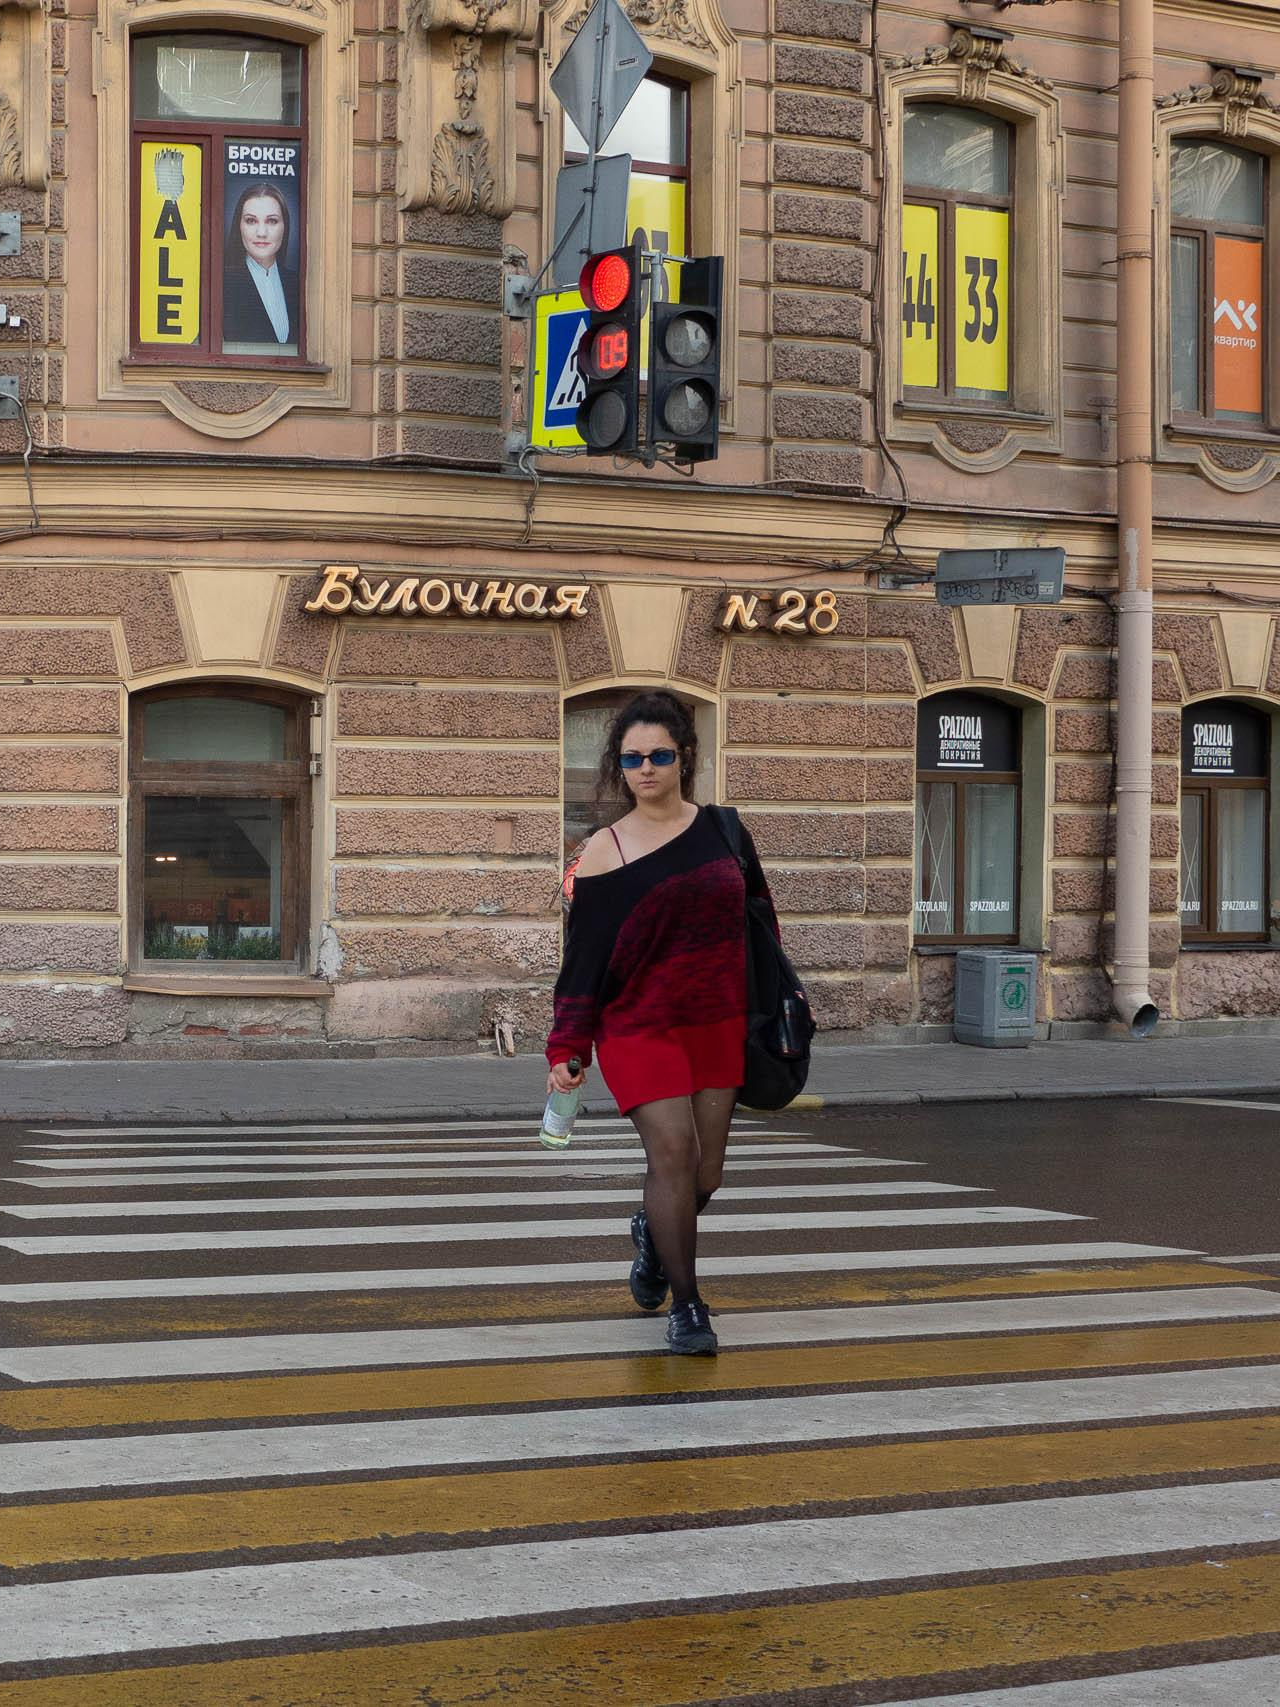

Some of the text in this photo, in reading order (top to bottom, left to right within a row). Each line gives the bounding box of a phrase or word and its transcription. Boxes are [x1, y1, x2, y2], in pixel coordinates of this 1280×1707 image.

[228, 145, 296, 162] БРОКЕР
[228, 162, 296, 176] ОБЪЕКТА
[902, 251, 999, 344] 44 33
[1214, 335, 1257, 350] квартир
[304, 565, 591, 617] Булочная
[773, 590, 839, 635] 28
[938, 715, 982, 739] SPAZZOLA
[1193, 723, 1233, 746] SPAZZOLA
[940, 740, 981, 750] ДЕКОРАТИВНЫЕ
[940, 750, 981, 760] ПОКРЫТИЯ
[1194, 757, 1232, 766] ПОКРЫТИЯ
[969, 901, 1010, 912] SPAZZOLA.RU
[1221, 901, 1259, 911] SPAZZOLA.RU
